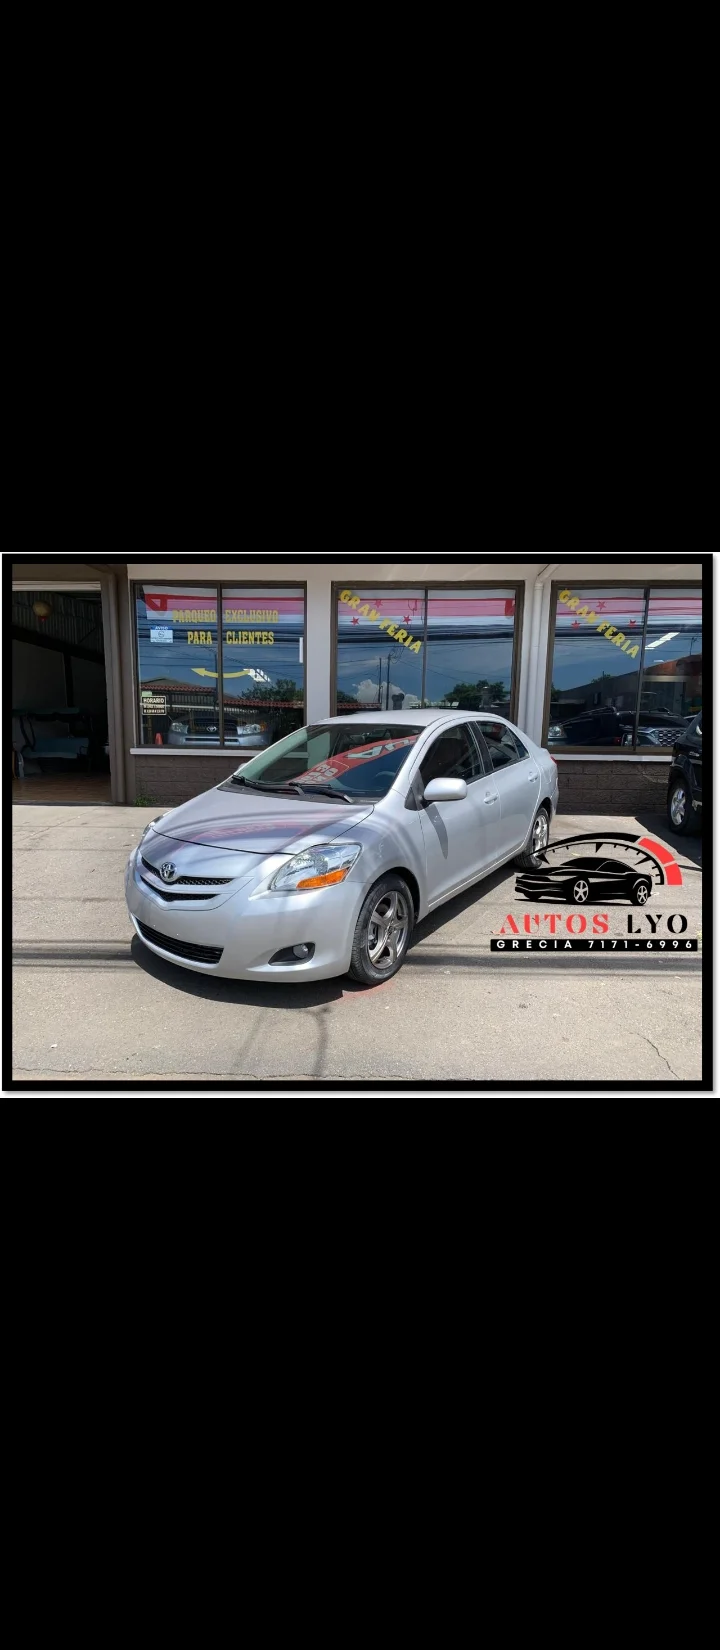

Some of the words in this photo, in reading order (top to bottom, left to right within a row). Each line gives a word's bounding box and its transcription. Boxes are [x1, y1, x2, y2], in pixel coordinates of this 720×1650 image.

[173, 609, 216, 623] PARQUEO
[224, 609, 279, 623] EXCLUSIVO
[340, 590, 380, 622] GRAN
[379, 618, 422, 653] FERIA
[559, 590, 599, 624] GRAN
[596, 621, 640, 658] FERIA
[187, 631, 213, 645] PARA
[226, 631, 275, 645] CLIENTES
